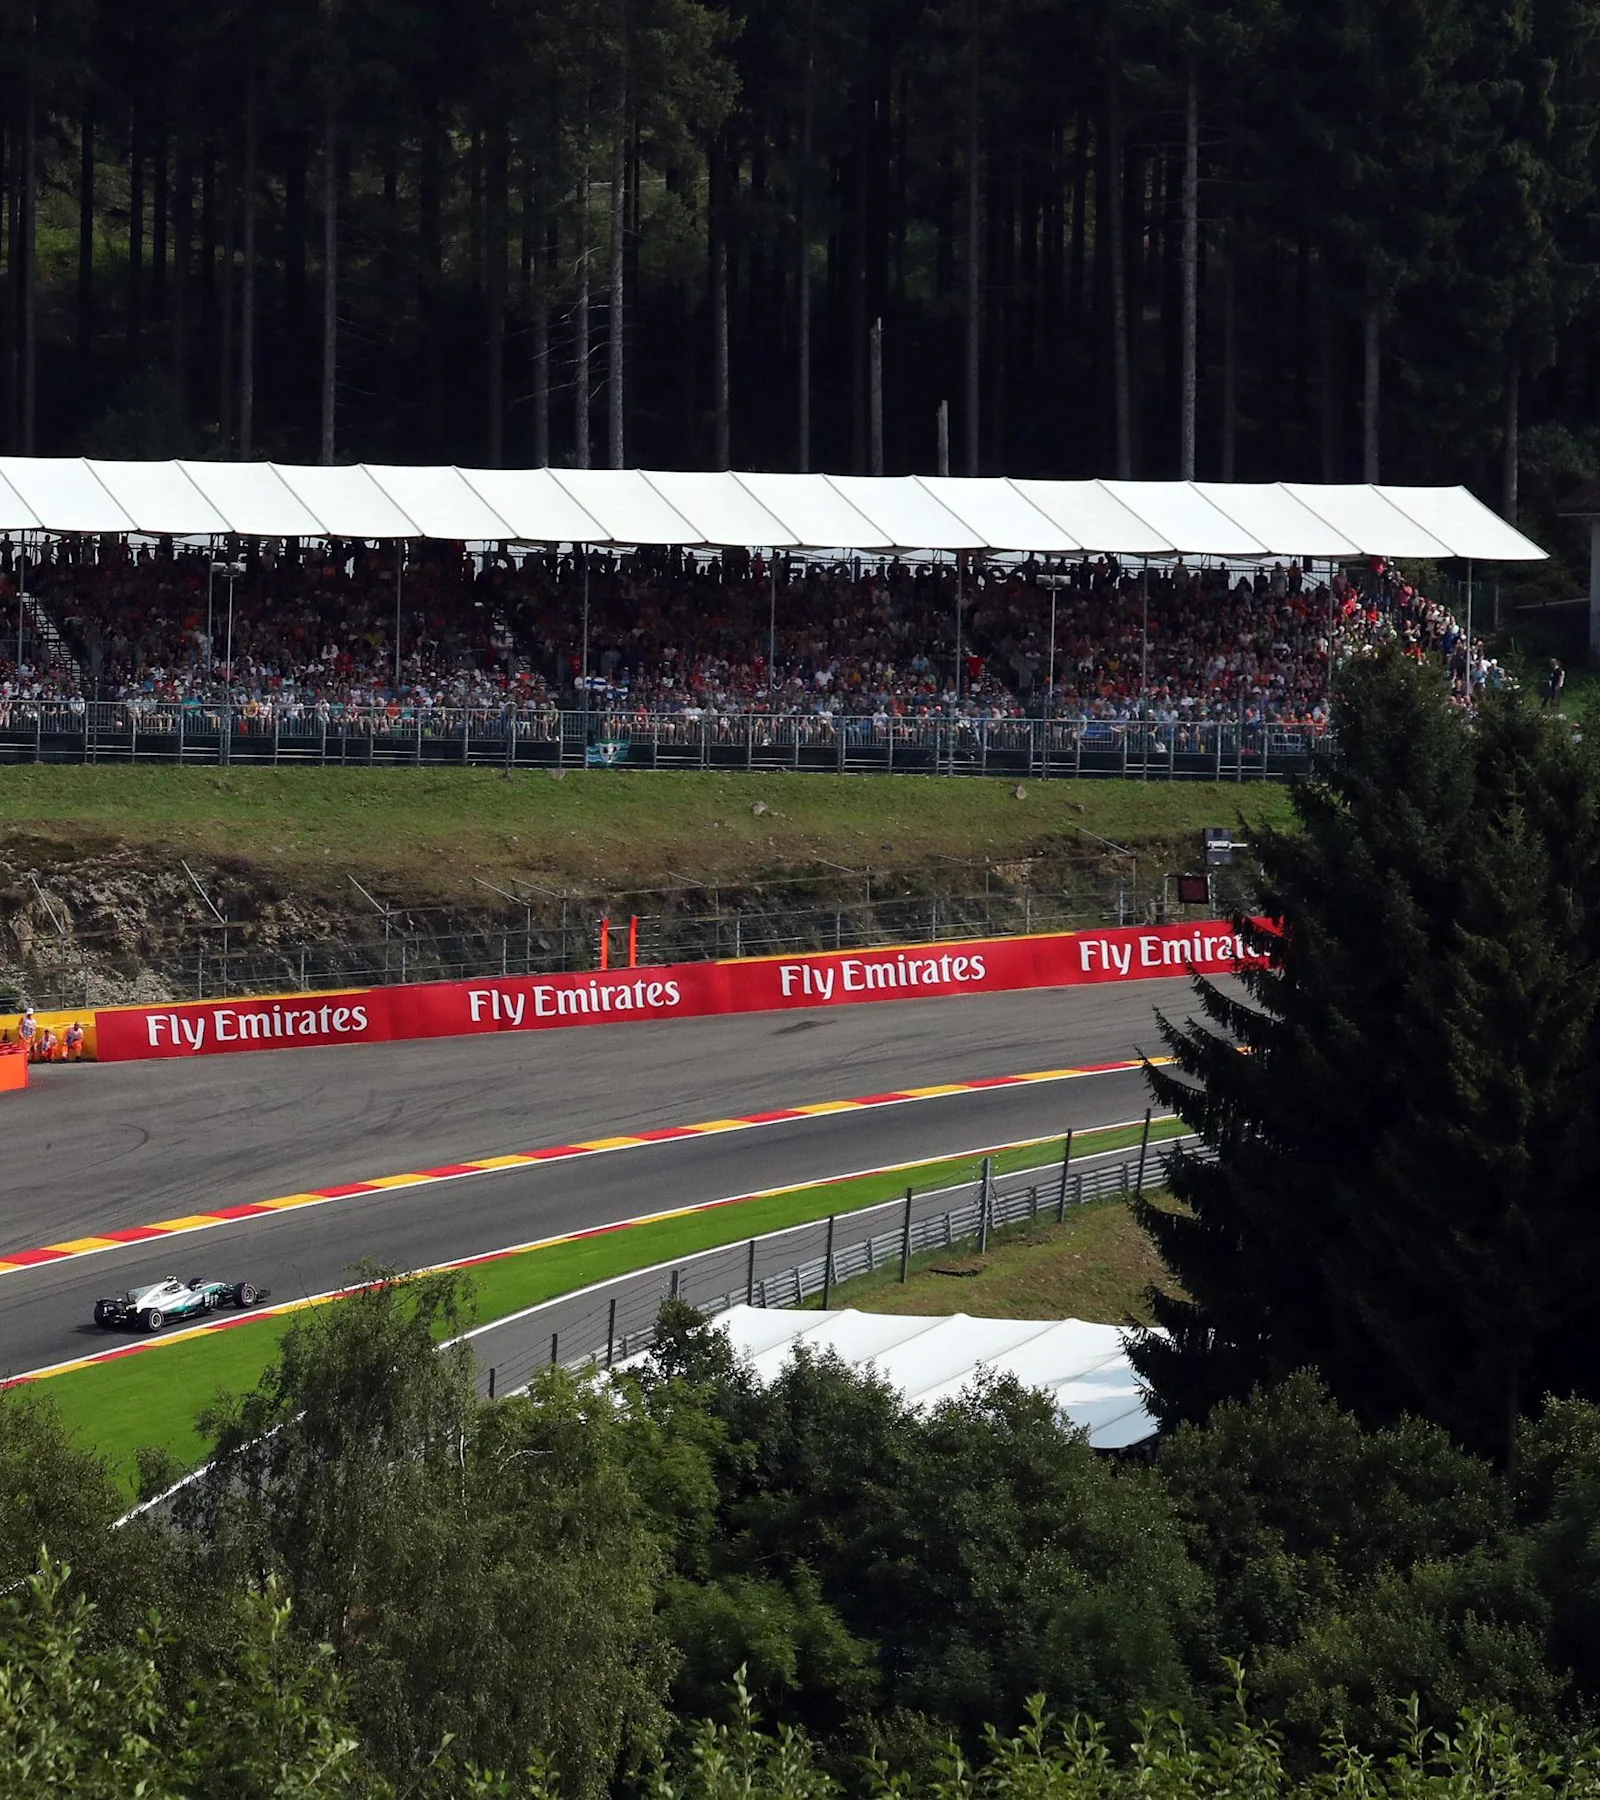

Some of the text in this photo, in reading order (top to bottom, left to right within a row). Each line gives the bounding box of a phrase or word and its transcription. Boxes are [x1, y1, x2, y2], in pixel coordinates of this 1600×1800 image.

[1078, 930, 1271, 975] Fly Emirat
[779, 953, 986, 1000] Fly Emirates
[468, 979, 681, 1026] Fly Emirates
[145, 1004, 368, 1050] Fly Emirates
